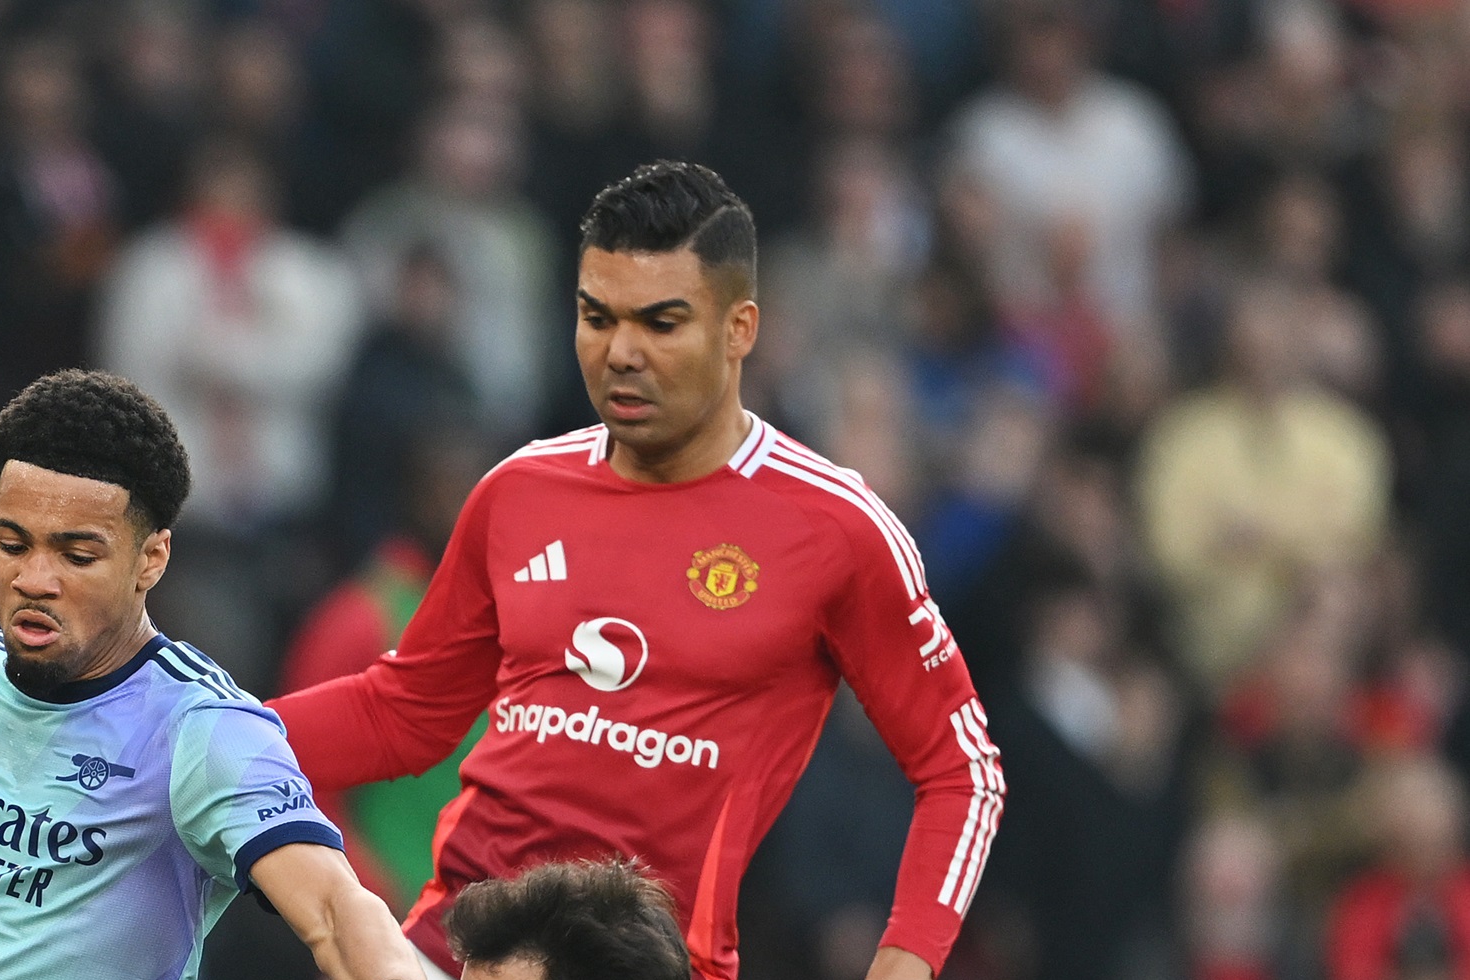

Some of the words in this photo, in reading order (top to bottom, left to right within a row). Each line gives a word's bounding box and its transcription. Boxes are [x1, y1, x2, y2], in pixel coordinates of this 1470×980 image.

[495, 696, 720, 769] Snapdragon
[271, 779, 303, 797] VI
[257, 794, 316, 822] RWA
